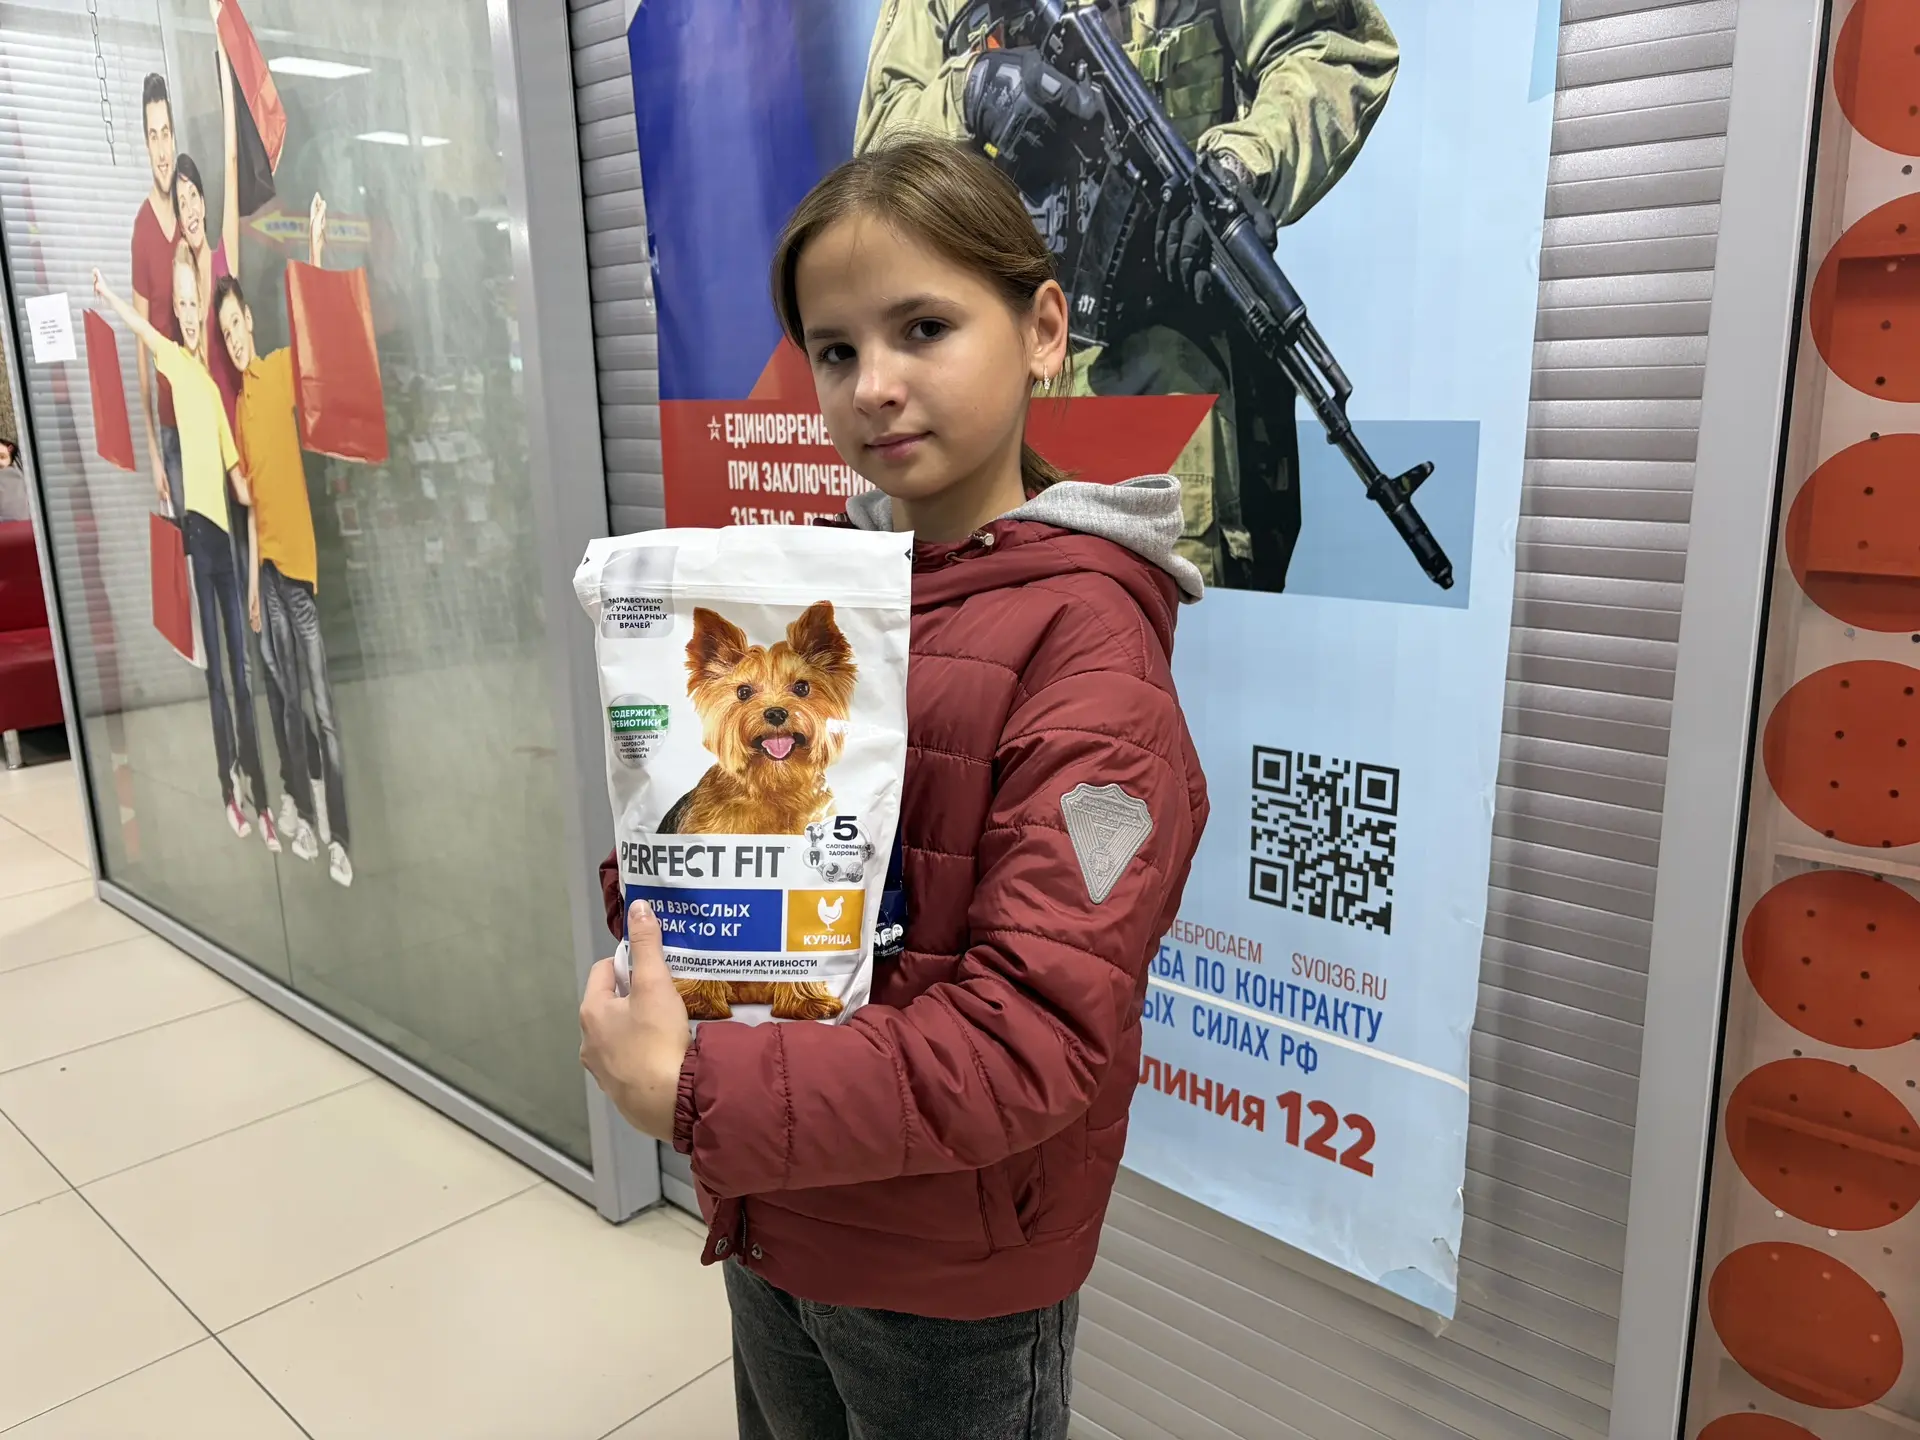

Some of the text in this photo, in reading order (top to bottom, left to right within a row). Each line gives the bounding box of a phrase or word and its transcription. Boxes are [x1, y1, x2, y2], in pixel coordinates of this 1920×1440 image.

[724, 412, 834, 449] ЕДИНОВРЕМЕ
[727, 460, 760, 491] ПРИ
[611, 708, 657, 719] СОДЕРЖИТ
[832, 815, 859, 841] 5
[620, 840, 785, 878] PERFECT FIT
[648, 899, 750, 918] ЛЯ ВЗРОСЛЫХ
[721, 923, 742, 937] КГ
[802, 933, 852, 946] КУРИЦА
[665, 954, 818, 967] ДЛЯ ПОДДЕРЖАНИЯ АКТИВНОСТИ
[671, 964, 703, 973] СОДЕРЖИТ
[1195, 955, 1225, 993] ПО
[1236, 968, 1383, 1043] КОНТРАКТУ
[1192, 1004, 1270, 1061] СИЛАХ
[1279, 1034, 1318, 1075] РФ
[1140, 1054, 1376, 1178] ЛИНИЯ 122
